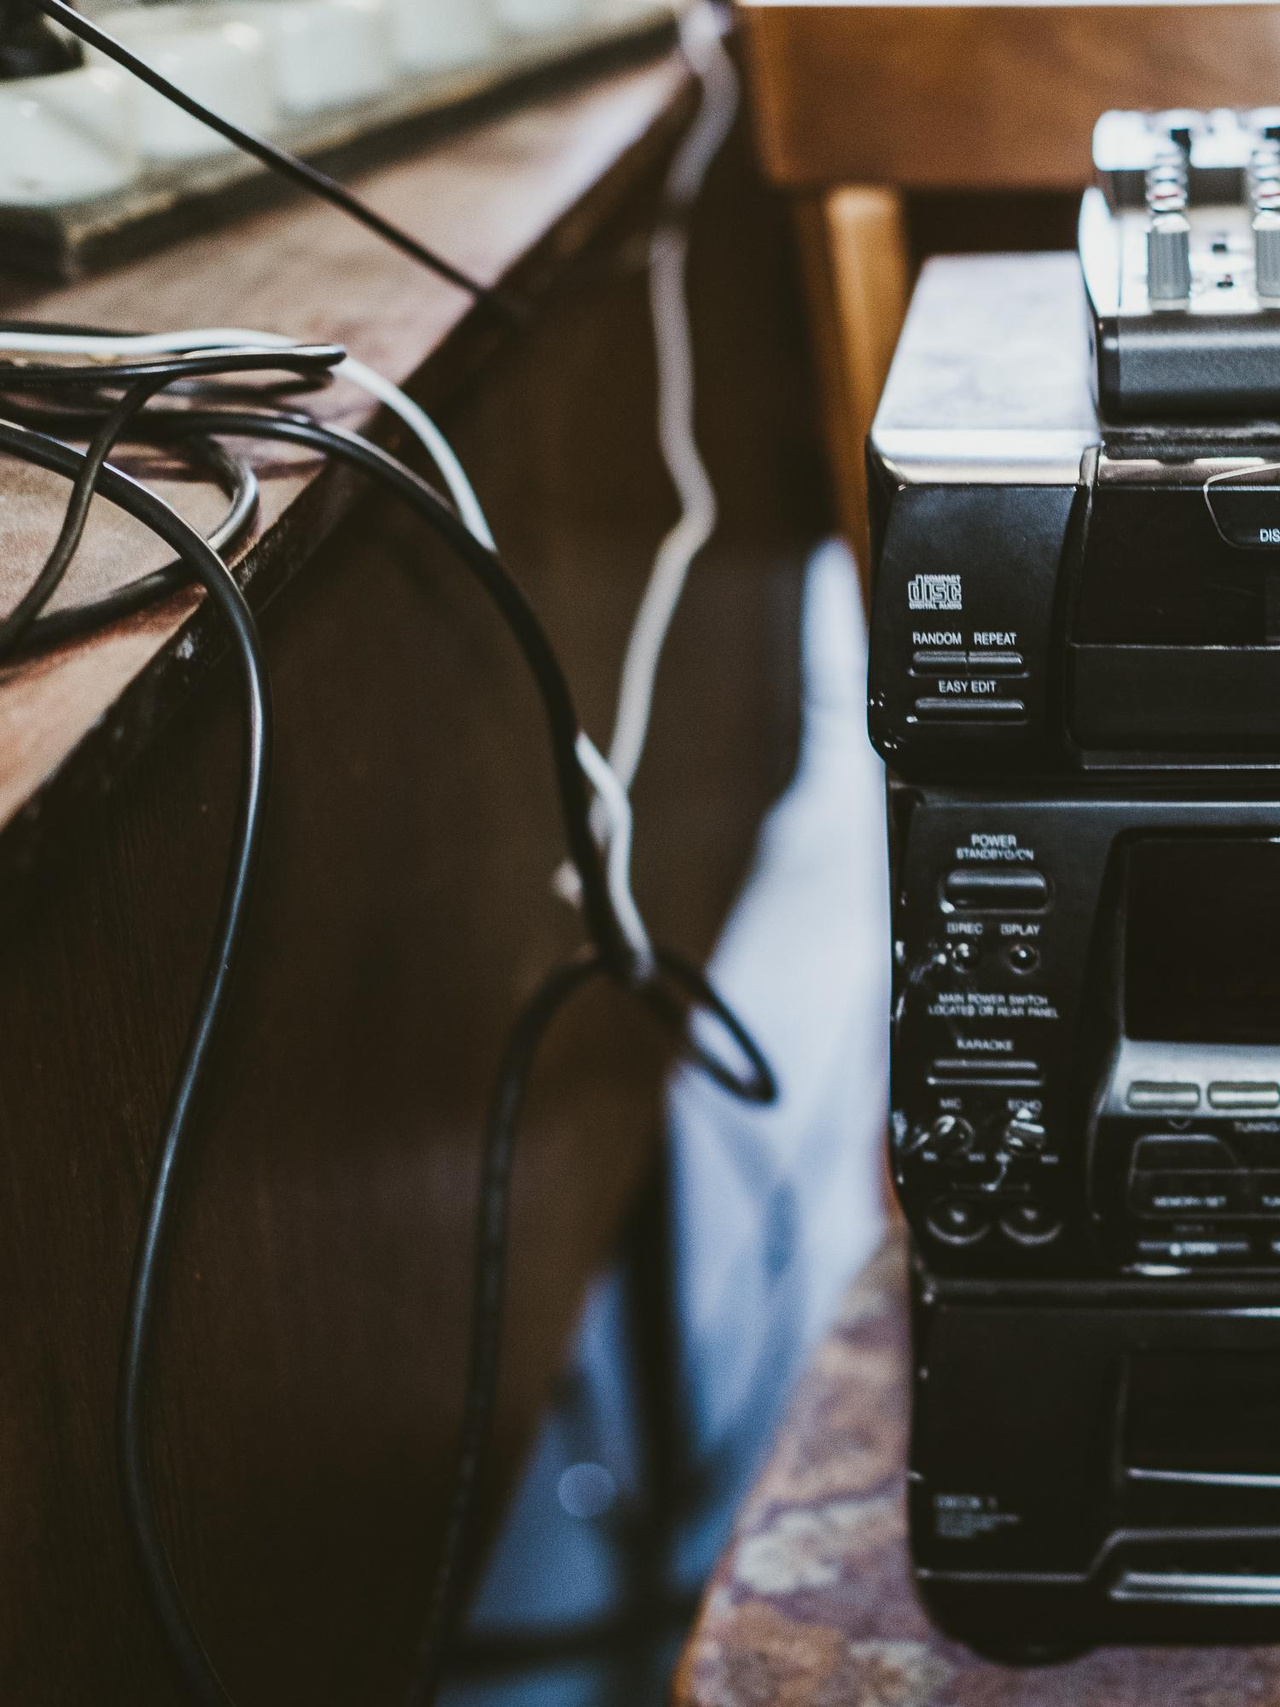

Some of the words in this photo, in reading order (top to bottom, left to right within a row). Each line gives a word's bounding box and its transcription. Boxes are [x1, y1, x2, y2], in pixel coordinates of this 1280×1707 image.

[909, 601, 938, 610] DIGITAL
[939, 601, 962, 610] AUDIO
[912, 631, 962, 645] RANDOM
[973, 632, 1017, 645] REPEAT
[938, 680, 969, 693] EASY
[971, 680, 997, 693] EDIT
[970, 833, 1017, 848] POWER
[938, 993, 965, 1003] MAIN
[967, 993, 1006, 1004] POWER
[1008, 994, 1048, 1006] SWITCH
[928, 1005, 976, 1016] LOCATED
[997, 1005, 1025, 1017] REAR
[1027, 1006, 1059, 1019] PANEL
[956, 1038, 1014, 1051] KARAOKE
